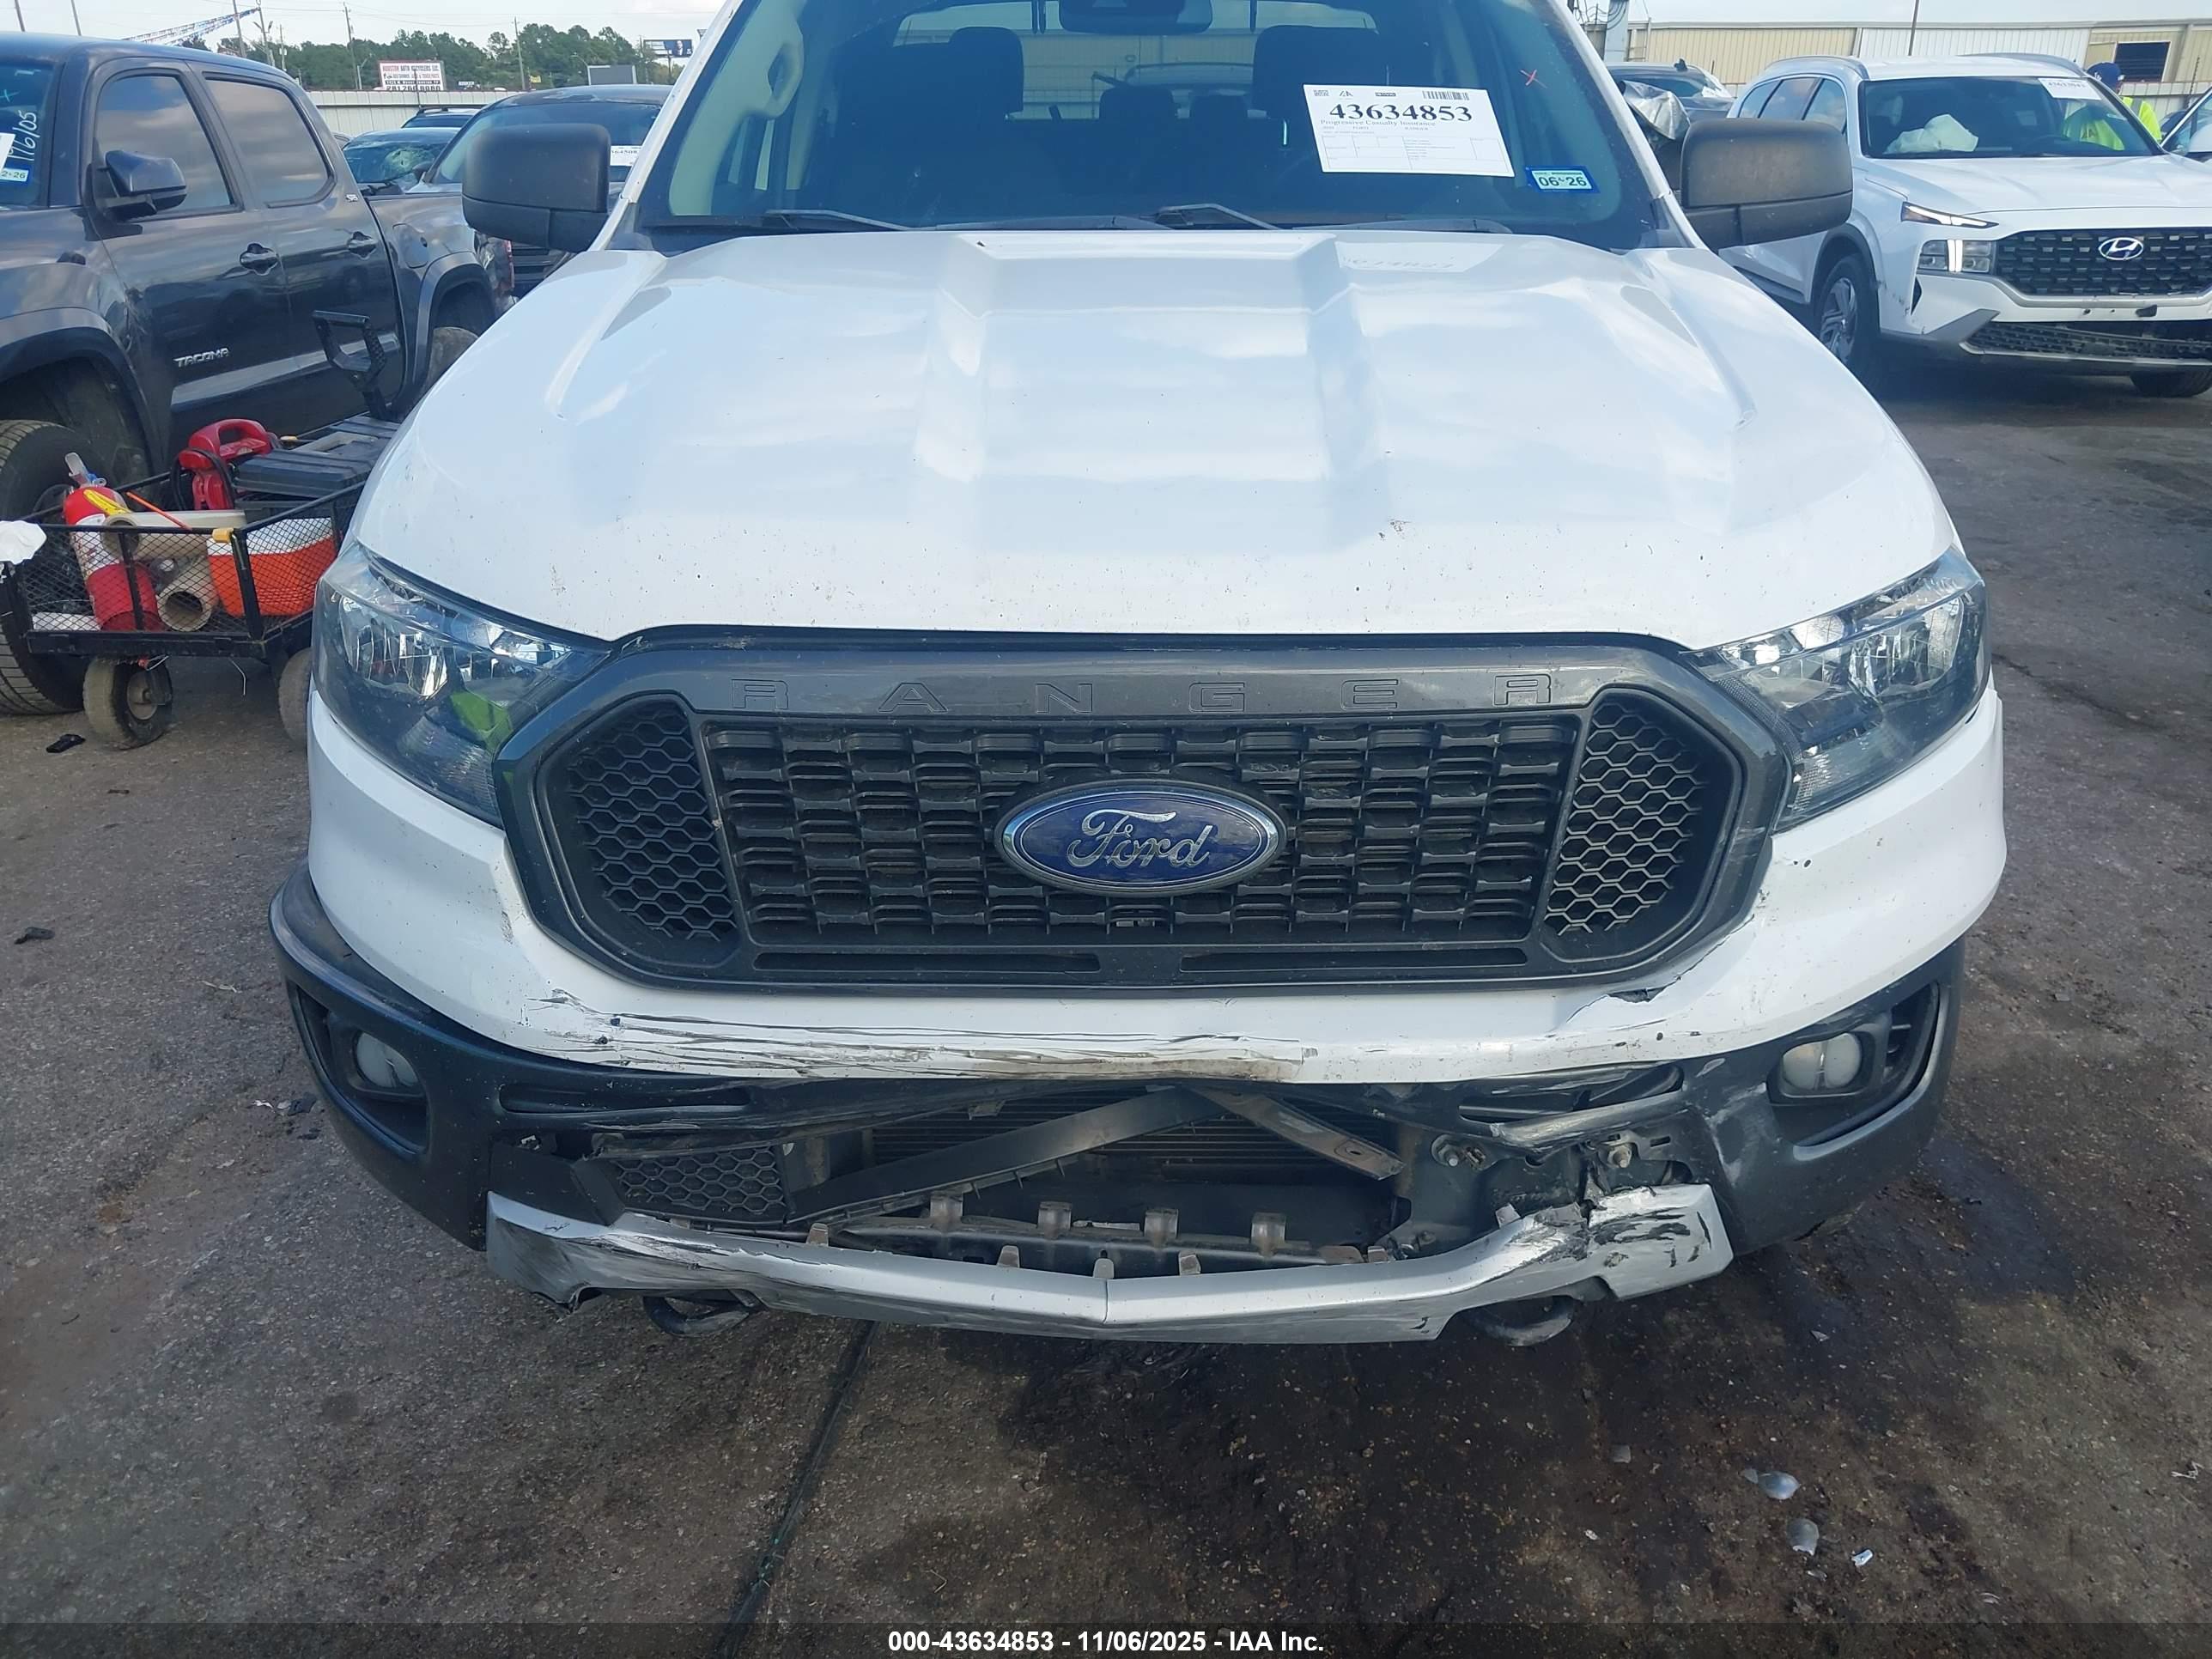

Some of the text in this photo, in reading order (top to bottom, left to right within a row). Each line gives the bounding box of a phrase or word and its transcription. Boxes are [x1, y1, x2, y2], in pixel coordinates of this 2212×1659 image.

[1330, 103, 1473, 122] 43634853
[1538, 176, 1588, 186] 06 26
[173, 347, 230, 368] TACOMA
[732, 673, 1553, 714] RANGER
[1066, 808, 1214, 867] Ford
